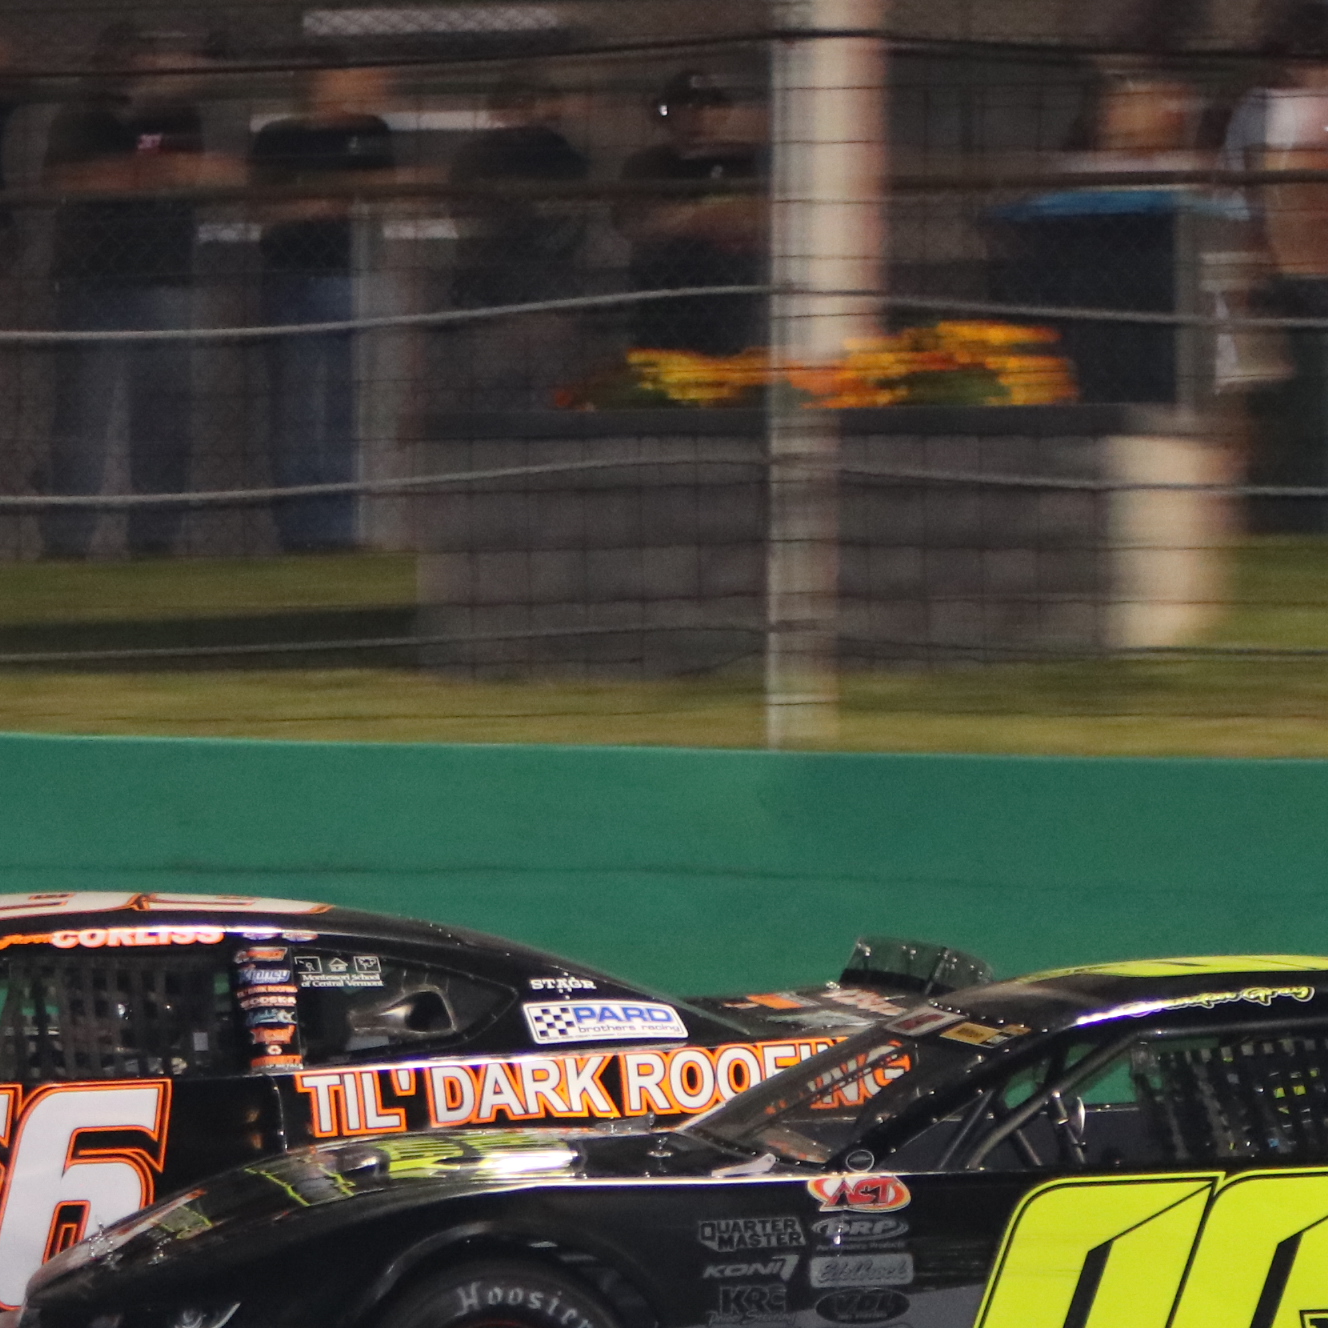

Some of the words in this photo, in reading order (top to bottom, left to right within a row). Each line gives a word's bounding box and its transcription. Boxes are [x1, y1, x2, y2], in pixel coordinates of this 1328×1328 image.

[50, 926, 224, 949] CORLISS
[302, 973, 350, 981] Montessori
[352, 973, 380, 981] School
[574, 1006, 674, 1024] PARD
[578, 1024, 637, 1034] brothers
[641, 1023, 680, 1034] racing
[296, 1068, 417, 1138] TIL'
[427, 1049, 621, 1128] DARK
[825, 1177, 895, 1207] ACT
[701, 1220, 796, 1241] QUARTER
[718, 1231, 803, 1250] MASTER
[703, 1261, 782, 1278] KONI
